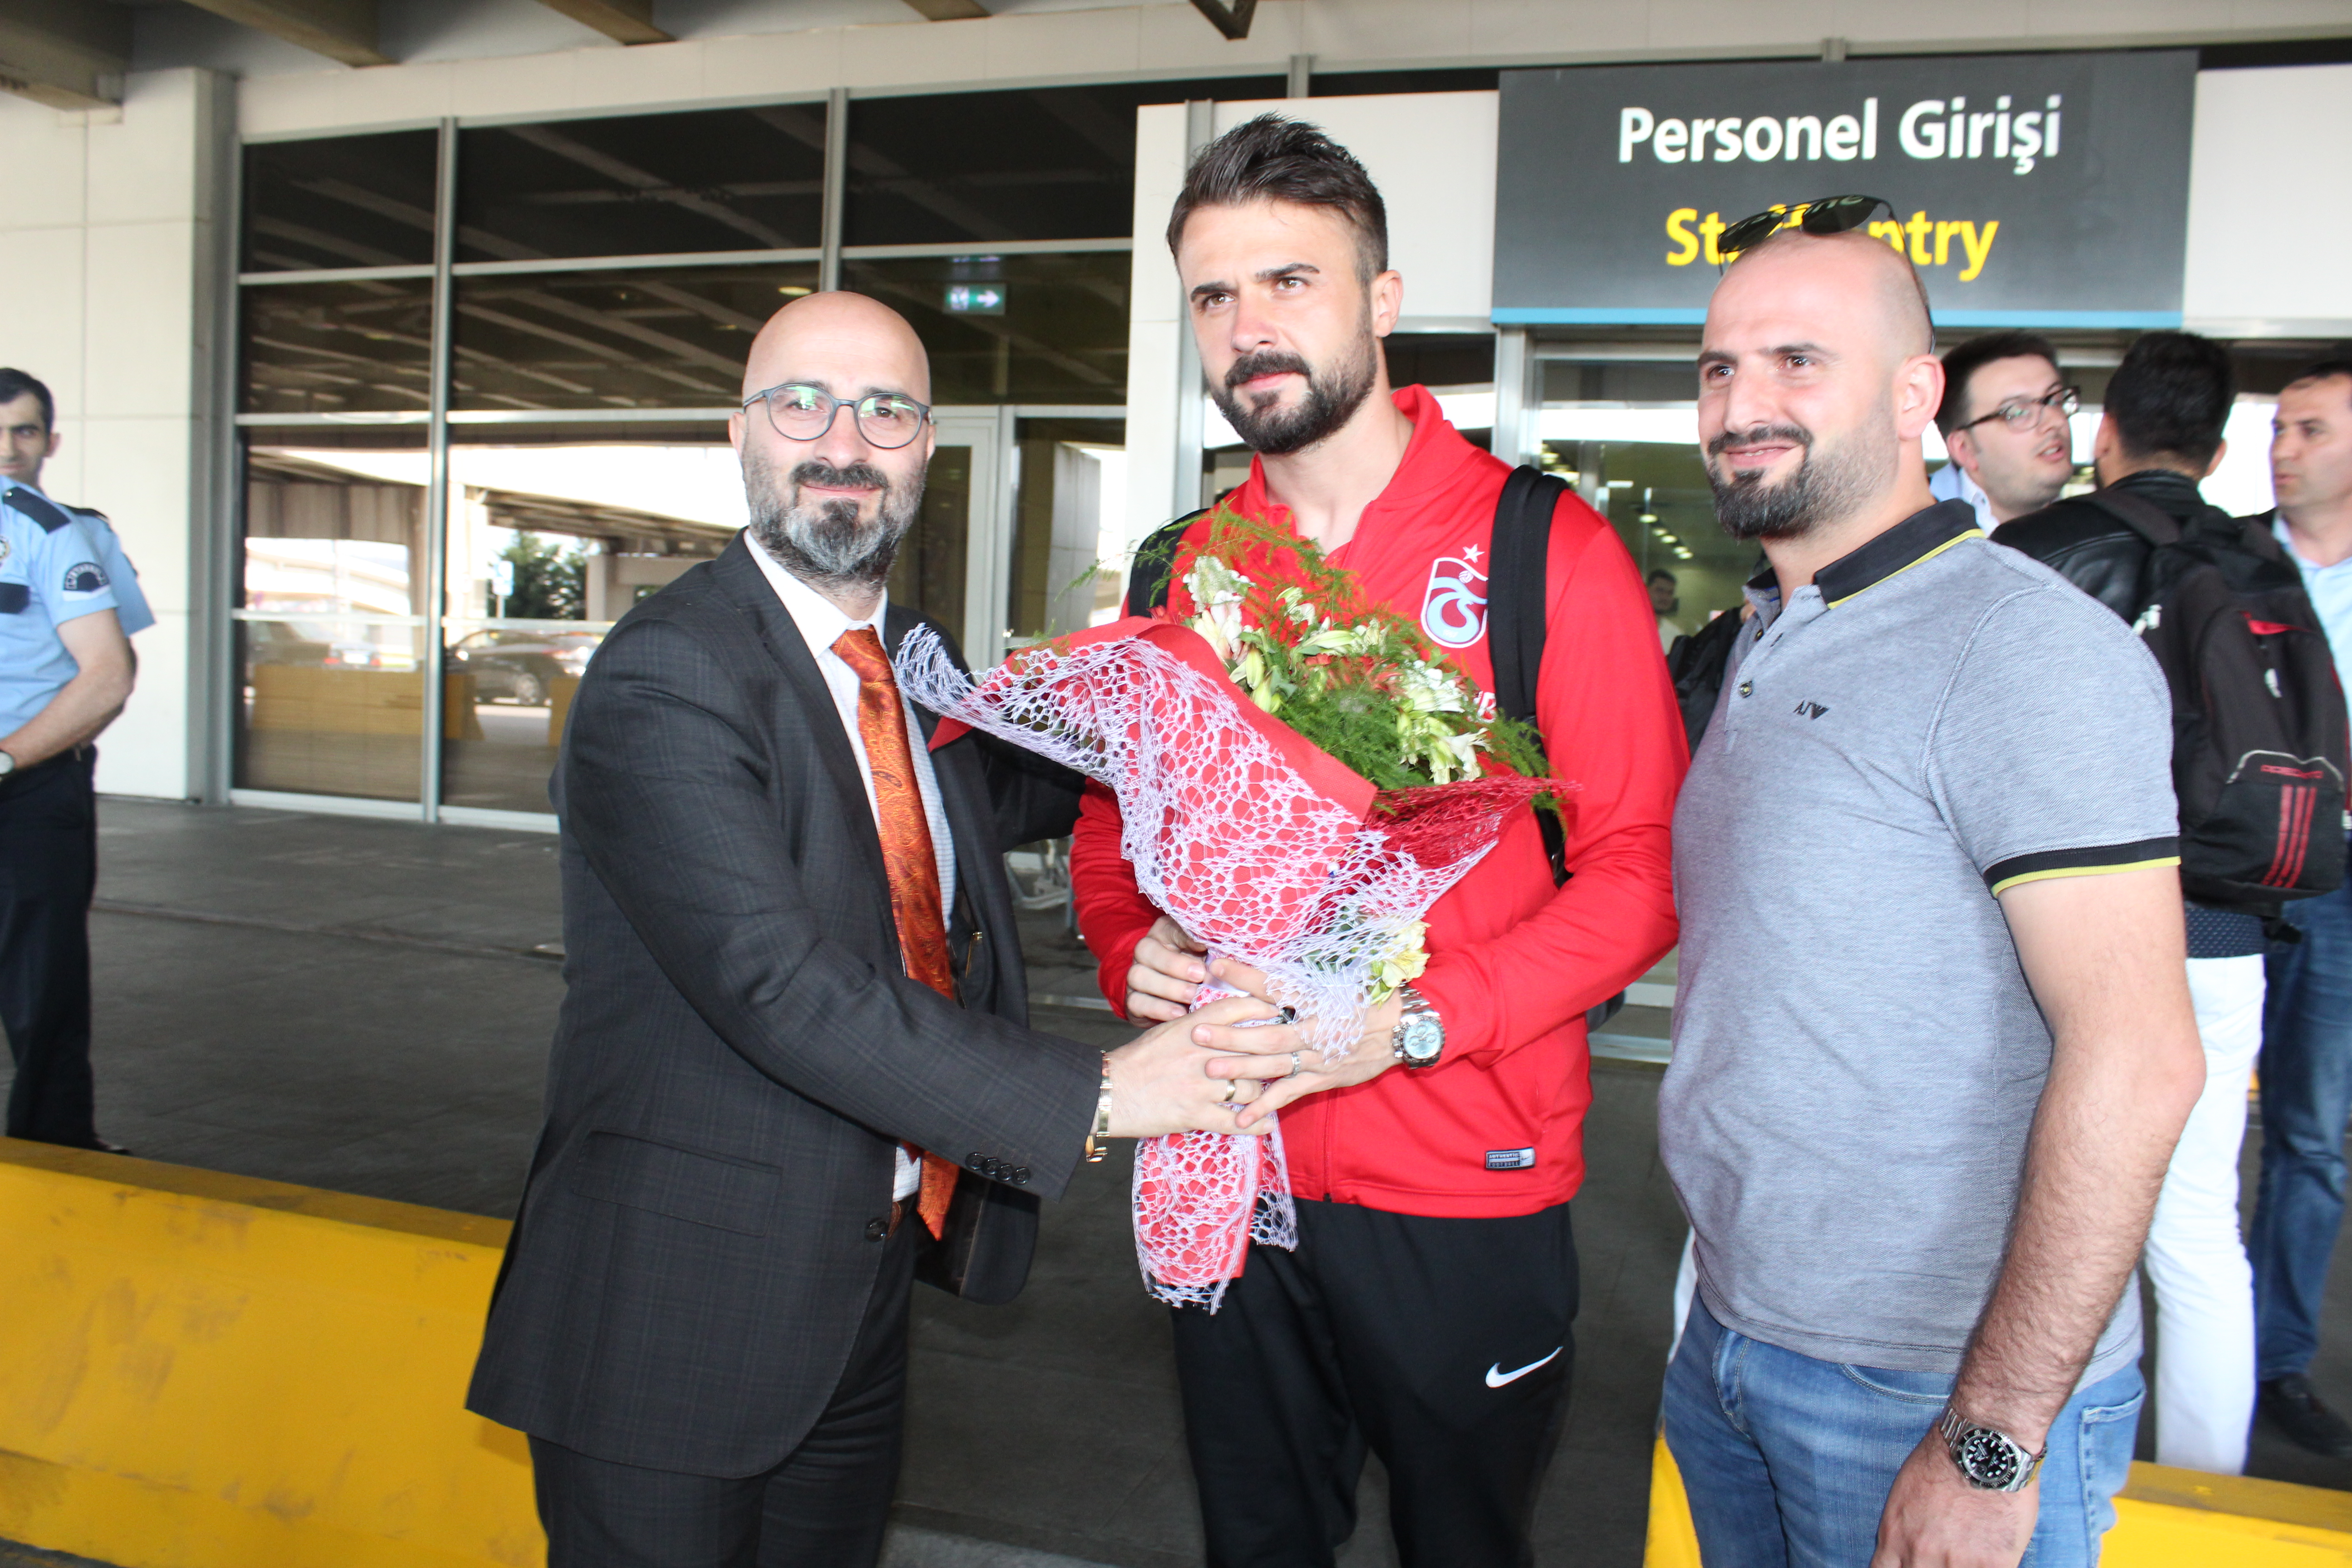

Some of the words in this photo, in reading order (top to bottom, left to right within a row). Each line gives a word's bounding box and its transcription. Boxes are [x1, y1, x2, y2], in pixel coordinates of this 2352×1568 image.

[1619, 97, 1878, 163] Personel
[1899, 95, 2062, 176] Girişi
[1867, 211, 1999, 282] ntry
